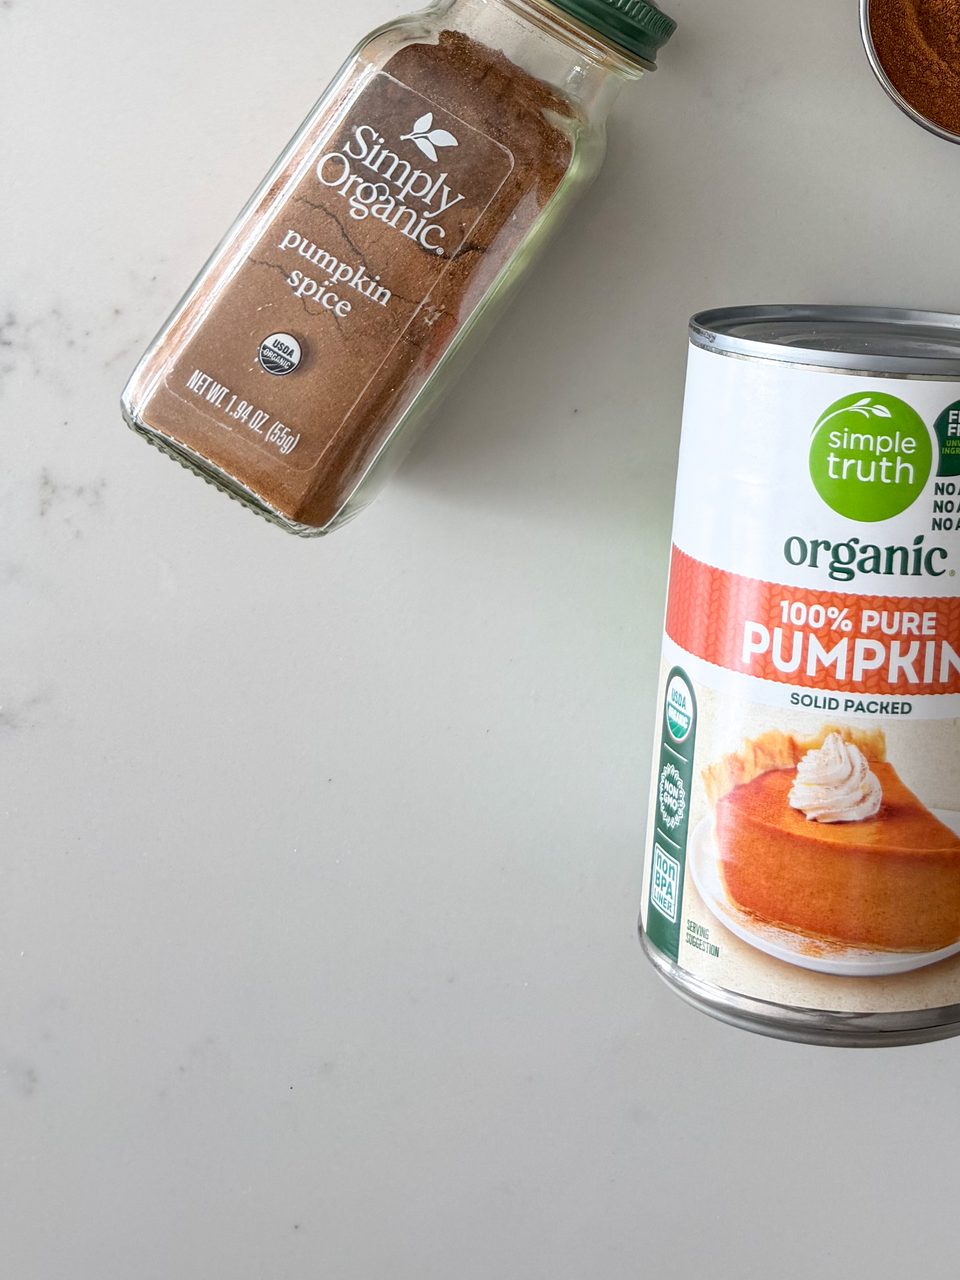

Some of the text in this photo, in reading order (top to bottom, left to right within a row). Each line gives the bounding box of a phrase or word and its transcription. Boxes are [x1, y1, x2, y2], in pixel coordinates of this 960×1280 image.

[342, 125, 465, 218] Simply
[278, 229, 392, 307] pumpkin
[286, 270, 352, 317] spice
[263, 348, 292, 369] ORGANIC
[273, 339, 295, 358] USDA
[186, 369, 300, 454] NET WT. 1.94 OZ. (55g)
[828, 427, 917, 456] simple
[827, 456, 914, 485] truth
[934, 482, 956, 495] NO
[933, 500, 955, 513] NO
[932, 517, 954, 531] NO
[784, 535, 948, 582] organic
[779, 599, 937, 636] 100% PURE
[790, 691, 912, 715] SOLID PACKED
[664, 778, 679, 799] NON
[655, 852, 676, 881] non
[655, 871, 673, 900] BPA
[686, 919, 710, 940] SERVING
[685, 932, 720, 958] SUGGESTION
